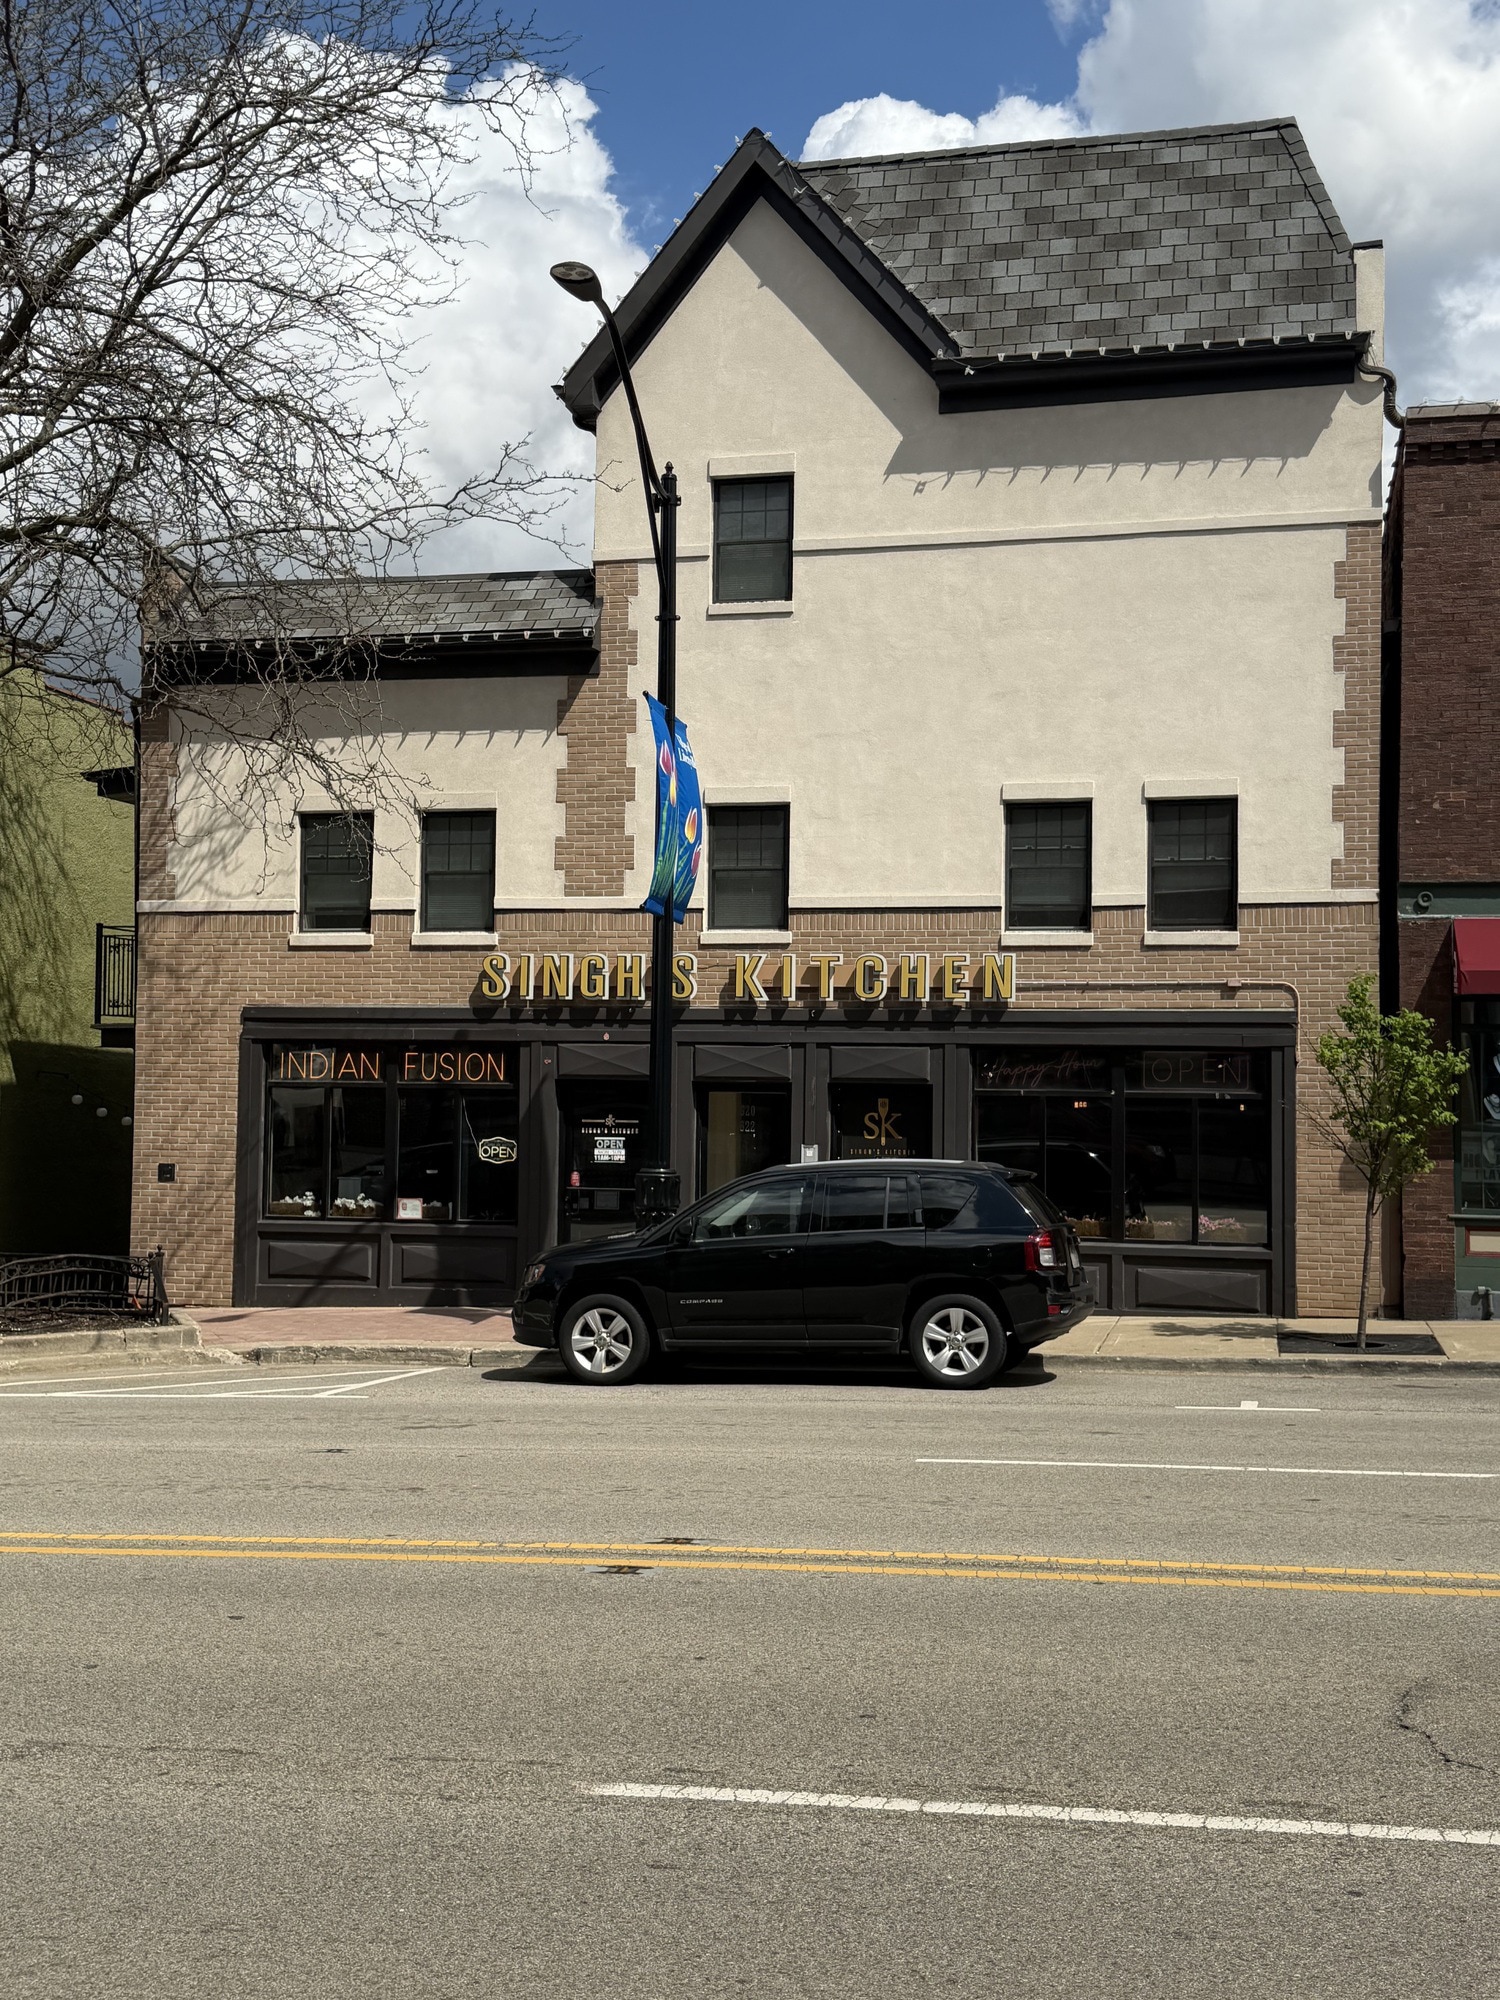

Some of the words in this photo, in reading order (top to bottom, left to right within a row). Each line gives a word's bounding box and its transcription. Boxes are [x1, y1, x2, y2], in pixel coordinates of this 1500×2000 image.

[734, 953, 1017, 1001] KITCHEN
[280, 1052, 380, 1080] INDIAN
[404, 1052, 505, 1082] FUSION
[989, 1056, 1051, 1088] Happy
[1057, 1049, 1100, 1078] Hour
[1151, 1057, 1241, 1084] OPEN
[481, 1146, 516, 1158] OPEN
[596, 1140, 624, 1149] OPEN
